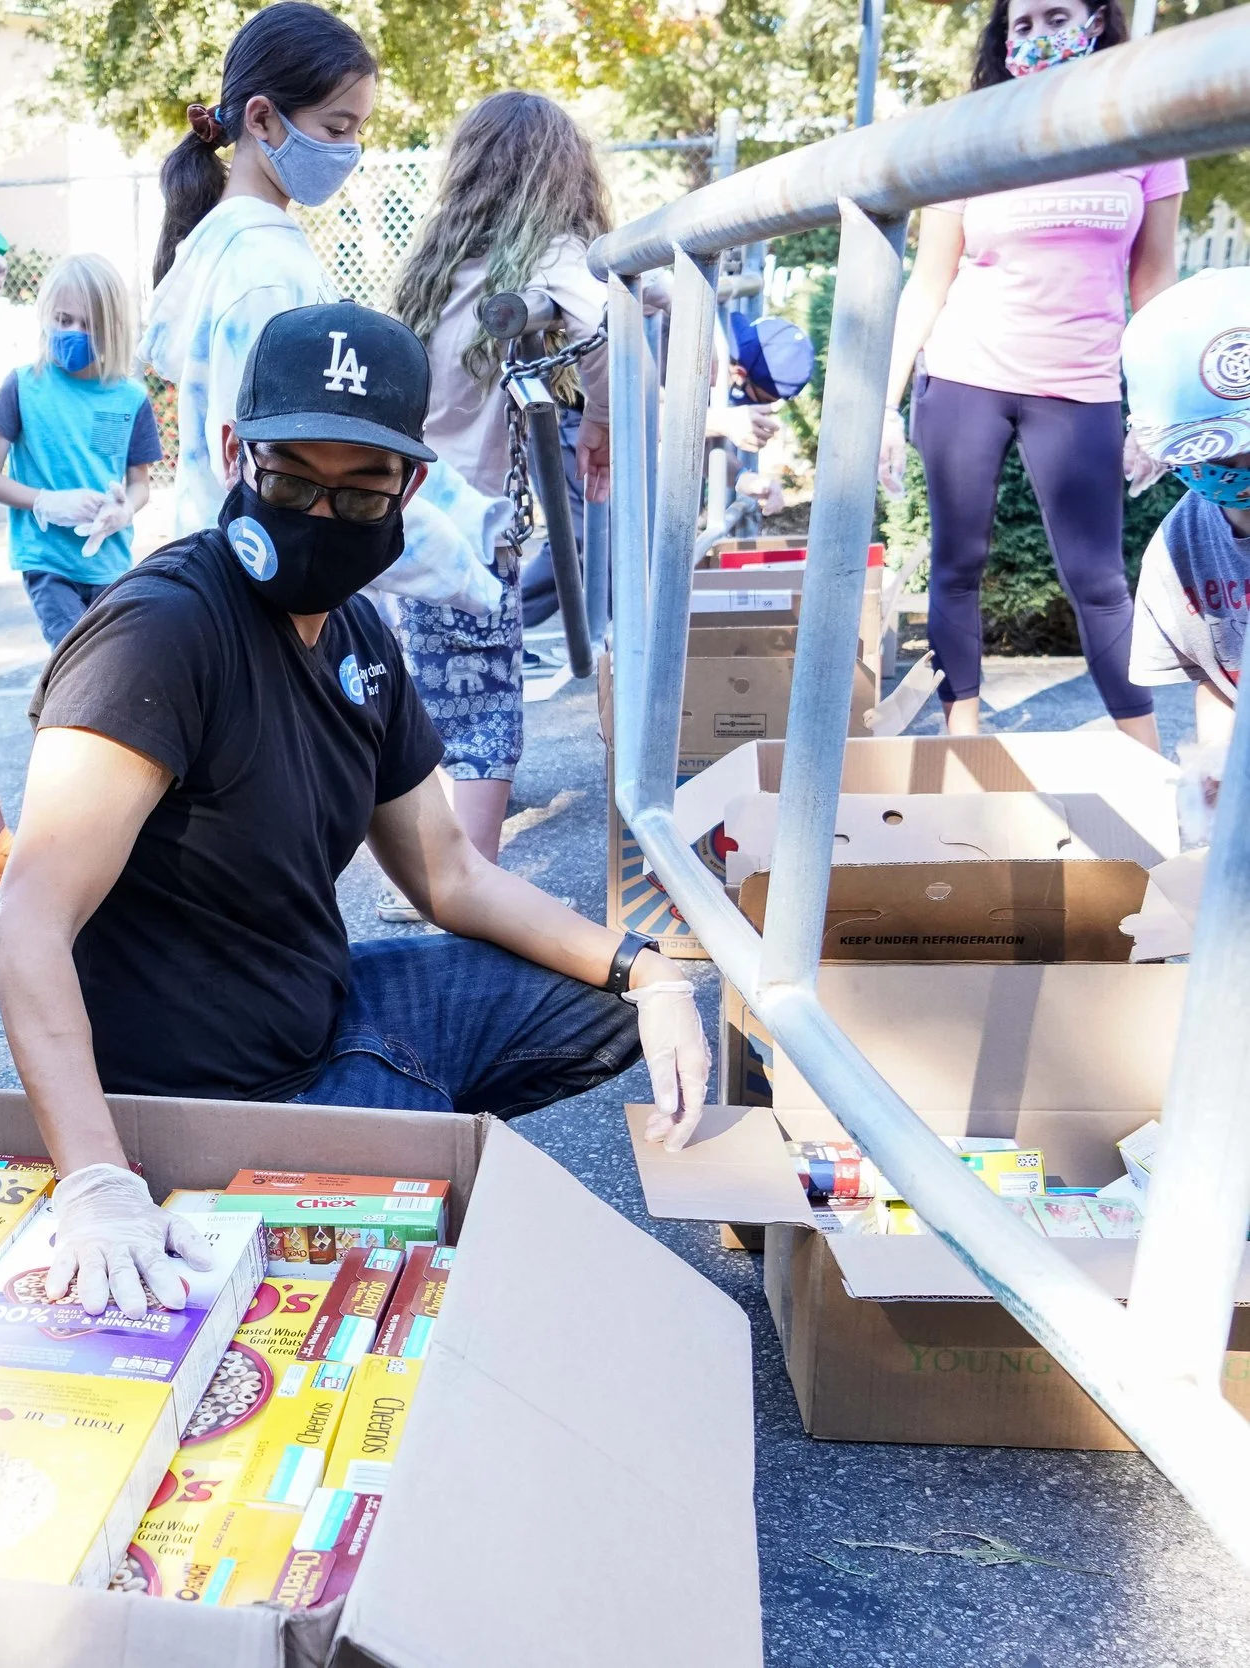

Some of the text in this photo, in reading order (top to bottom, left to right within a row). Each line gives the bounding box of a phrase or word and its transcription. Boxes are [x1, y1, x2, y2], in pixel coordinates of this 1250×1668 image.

[1012, 197, 1127, 213] ARPENTER
[323, 330, 368, 396] LA
[840, 935, 1025, 945] KEEP UNDER REFRIGERATION
[295, 1199, 358, 1209] Chex
[287, 1249, 308, 1258] Chex
[353, 1280, 388, 1317] Cheerios
[104, 1310, 171, 1324] VITINS
[95, 1317, 171, 1333] MINERALS
[237, 1326, 307, 1337] oasted Whole
[250, 1337, 302, 1347] Grain Oats
[267, 1346, 300, 1356] Cereal
[74, 1417, 125, 1435] From
[295, 1402, 334, 1445] Cheerios
[361, 1397, 405, 1454] Cheerios
[138, 1519, 200, 1533] sted Whol
[137, 1531, 194, 1545] Grain Oat
